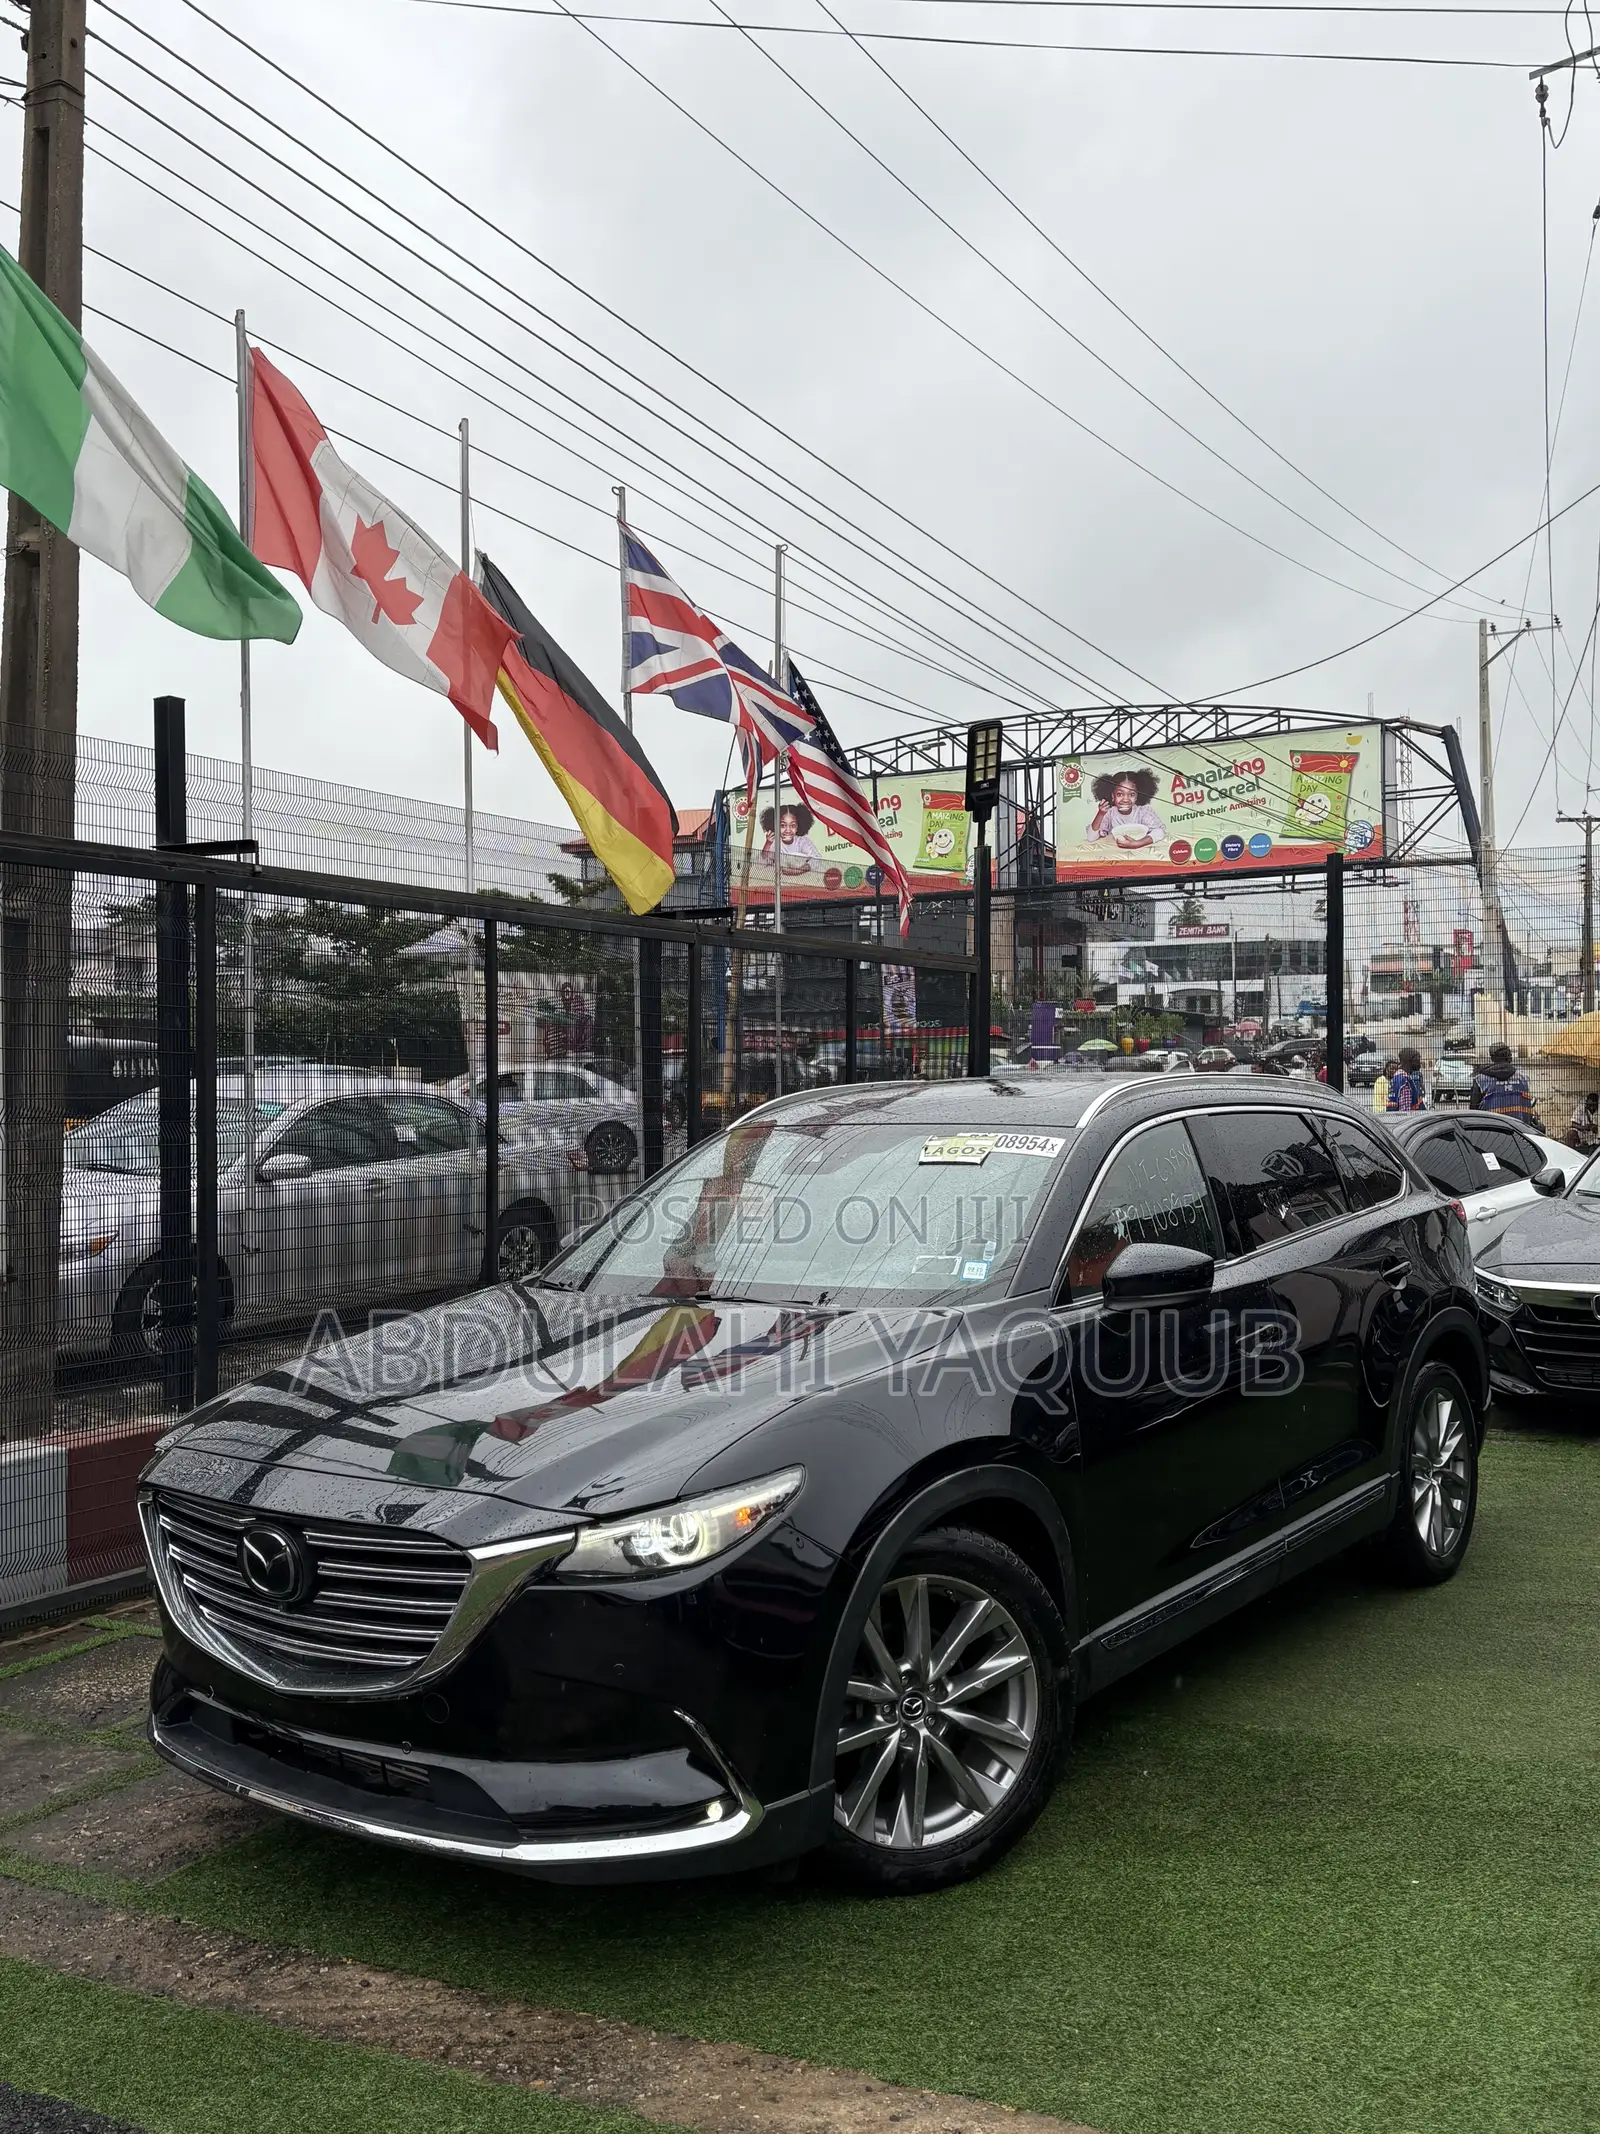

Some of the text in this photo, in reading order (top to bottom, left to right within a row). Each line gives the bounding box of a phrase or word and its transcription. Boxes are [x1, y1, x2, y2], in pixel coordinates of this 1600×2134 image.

[1170, 757, 1266, 793] Amaizing
[1172, 777, 1260, 806] Day Cereal
[1299, 784, 1318, 793] DAY
[1170, 811, 1205, 823] Nurture
[1207, 805, 1227, 816] their
[929, 820, 945, 828] DAY
[1178, 925, 1227, 936] ZENITH BANK
[923, 1146, 988, 1155] LAGOS
